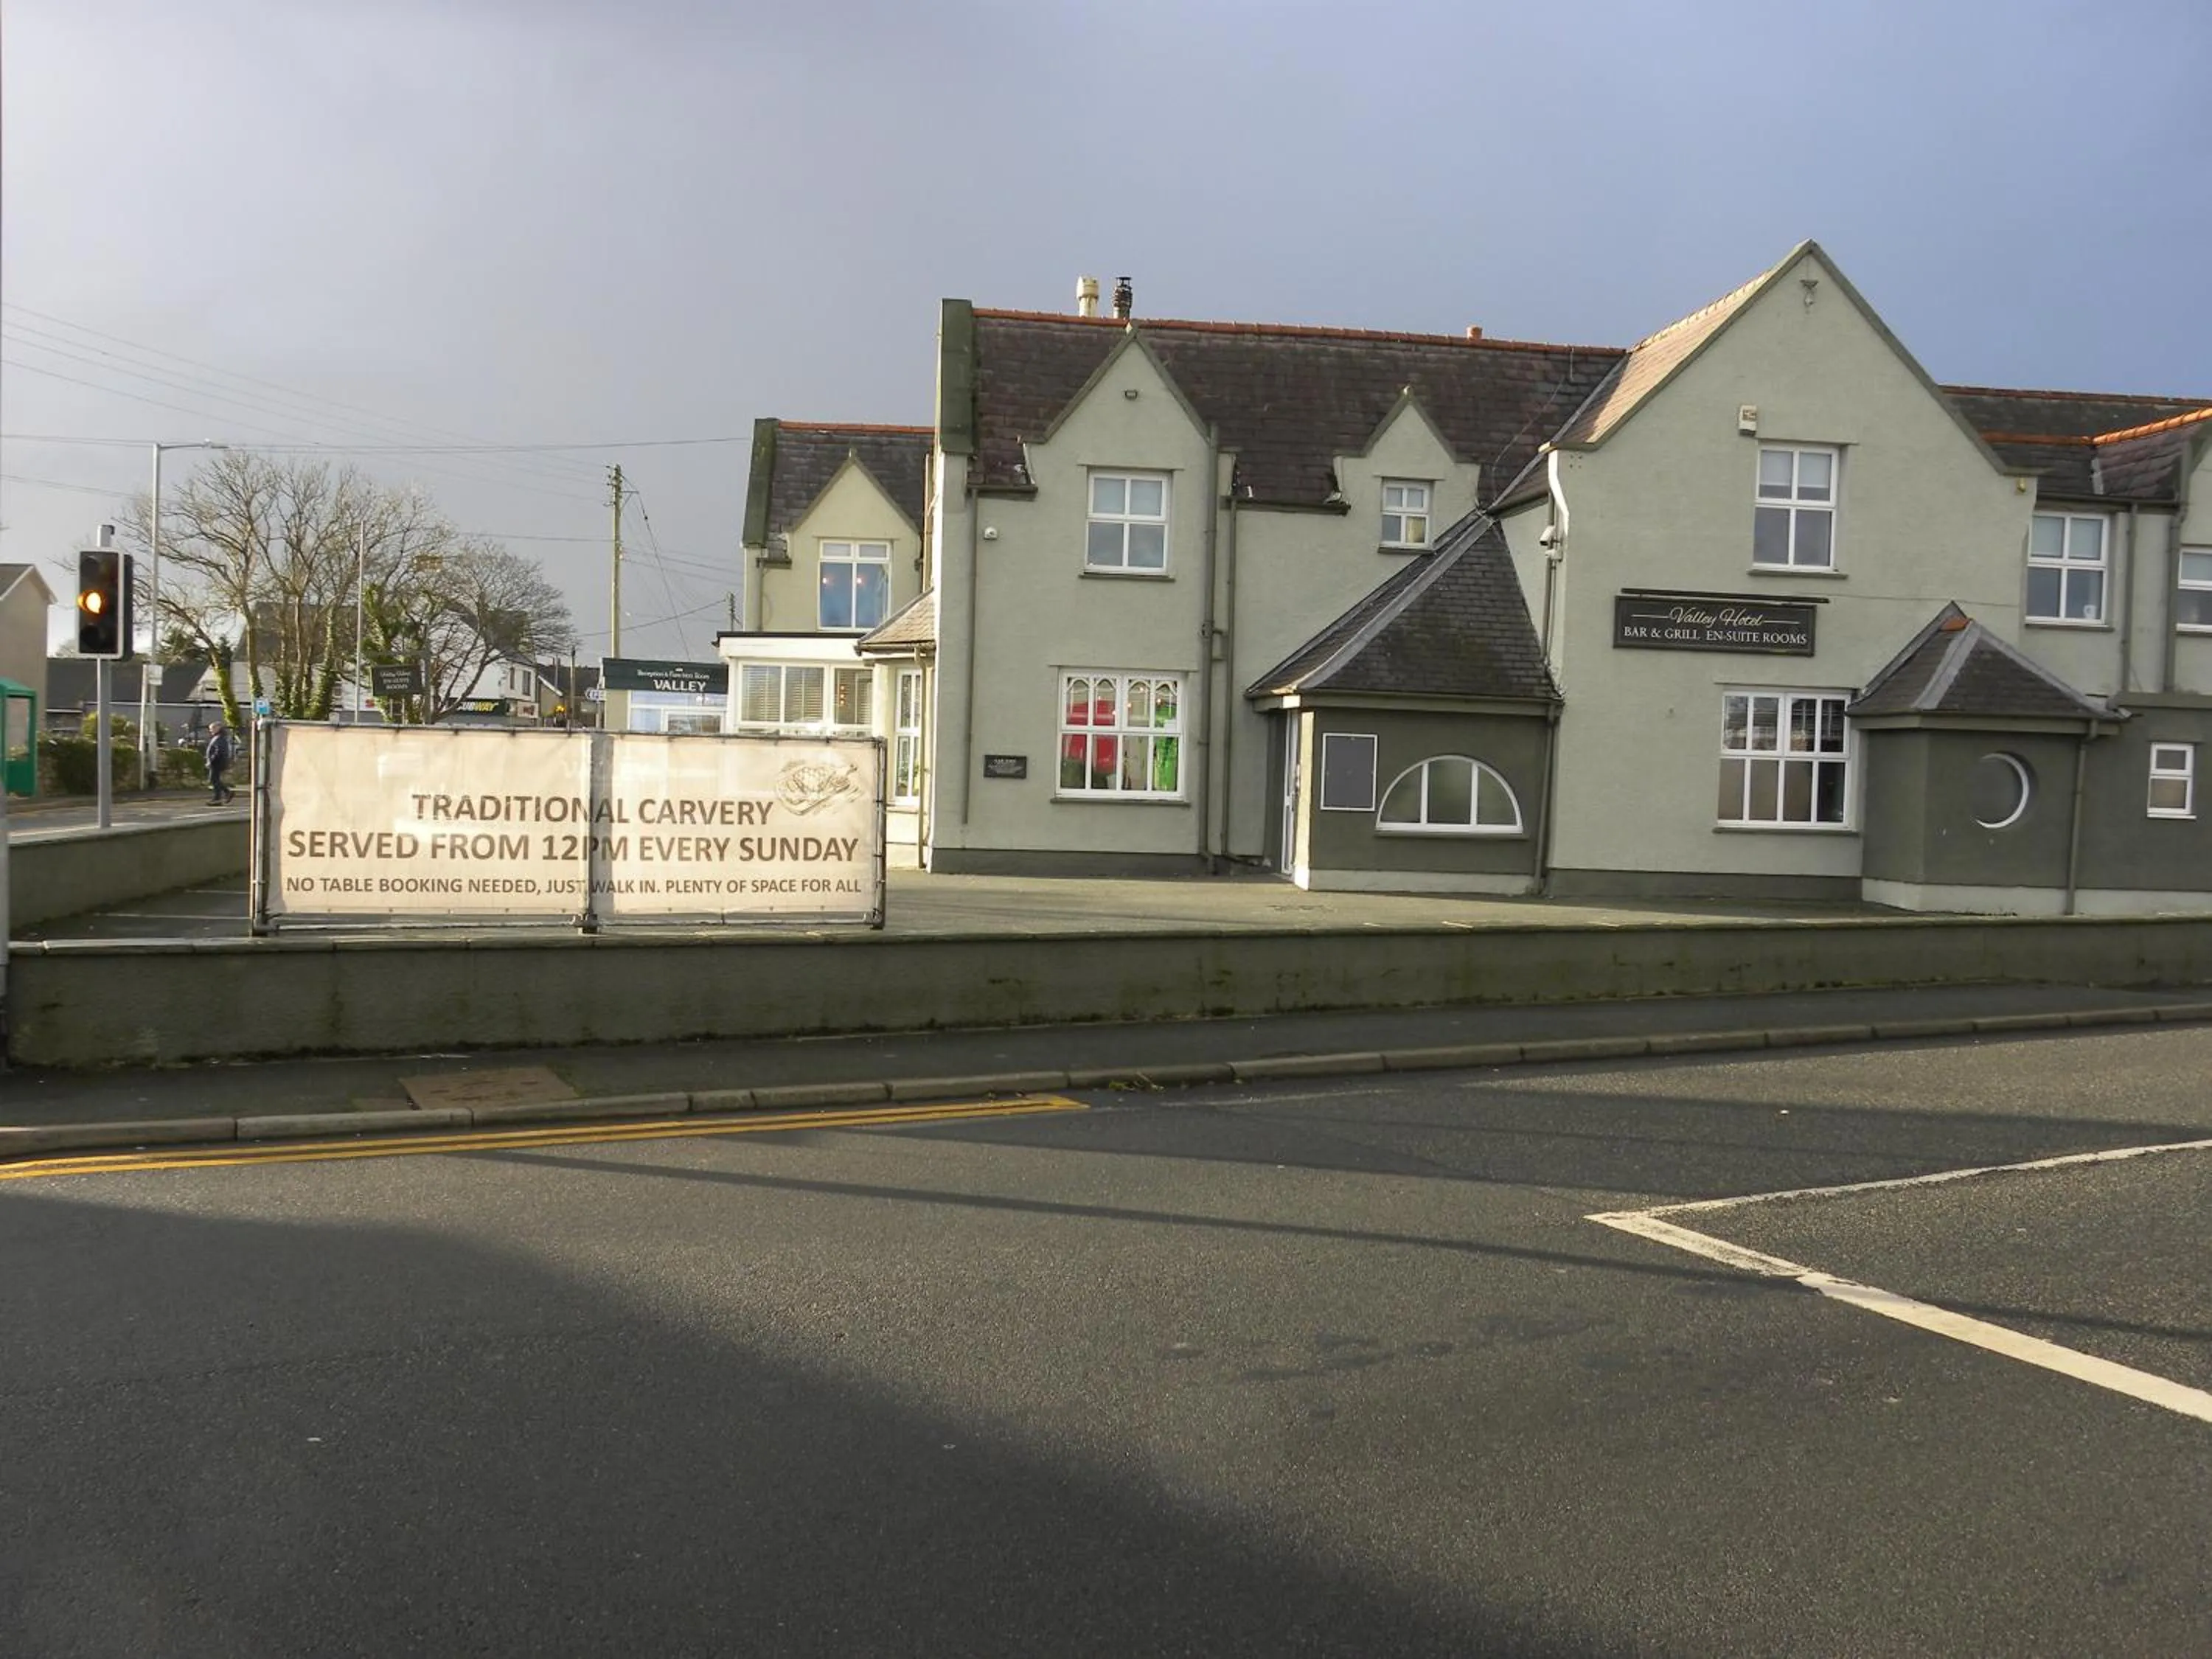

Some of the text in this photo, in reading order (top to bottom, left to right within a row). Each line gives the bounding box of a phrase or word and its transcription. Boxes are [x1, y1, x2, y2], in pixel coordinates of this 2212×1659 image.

[1669, 607, 1764, 627] Valley Hotel
[1624, 627, 1647, 638] BAR
[1651, 627, 1660, 638] &
[1664, 628, 1700, 640] GRILL
[1762, 633, 1806, 645] ROOMS
[653, 679, 706, 692] VALLEY
[411, 794, 773, 825] TRADITIONAL CARVERY
[288, 830, 858, 862] SERVED FROM 12PM EVERY SUNDAY
[287, 877, 862, 895] NO TABLE BOOKING NEEDED, JUST WALK IN. PLENTY OF SPACE FOR ALL
